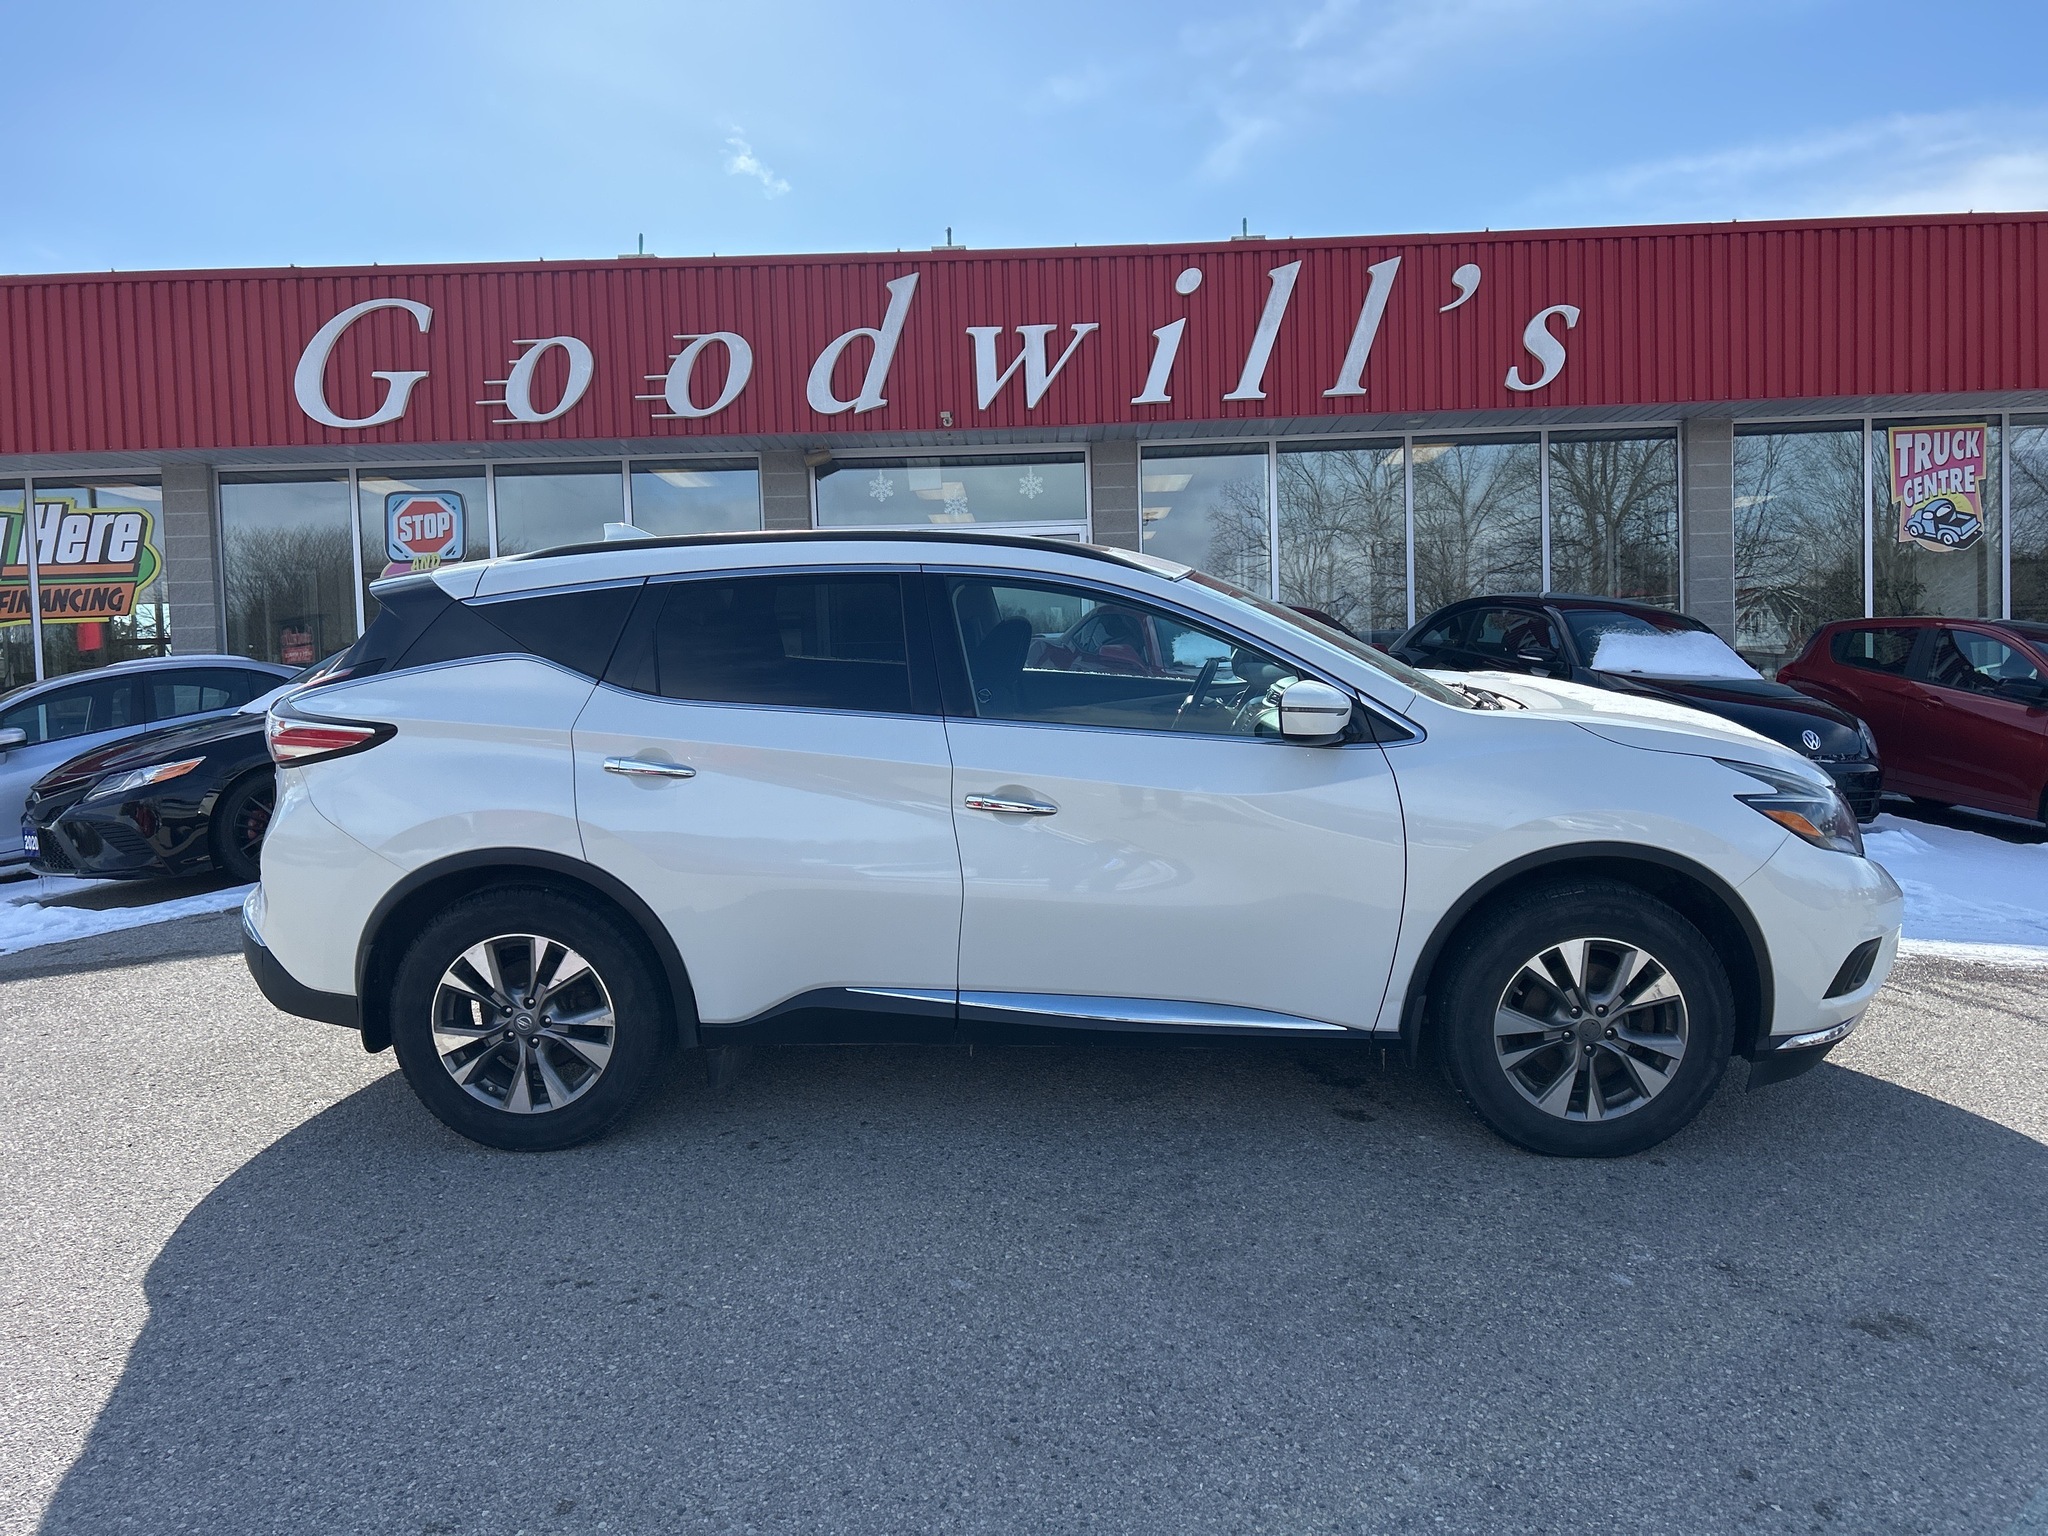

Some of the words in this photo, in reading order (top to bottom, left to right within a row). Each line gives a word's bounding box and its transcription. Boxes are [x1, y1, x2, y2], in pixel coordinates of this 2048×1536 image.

[294, 255, 1580, 430] Goodwill's
[1895, 430, 1981, 478] TRUCK
[1903, 464, 1976, 508] CENTRE
[16, 503, 143, 565] Here
[399, 511, 450, 542] STOP
[411, 553, 441, 571] AND
[0, 586, 124, 613] FINANCING
